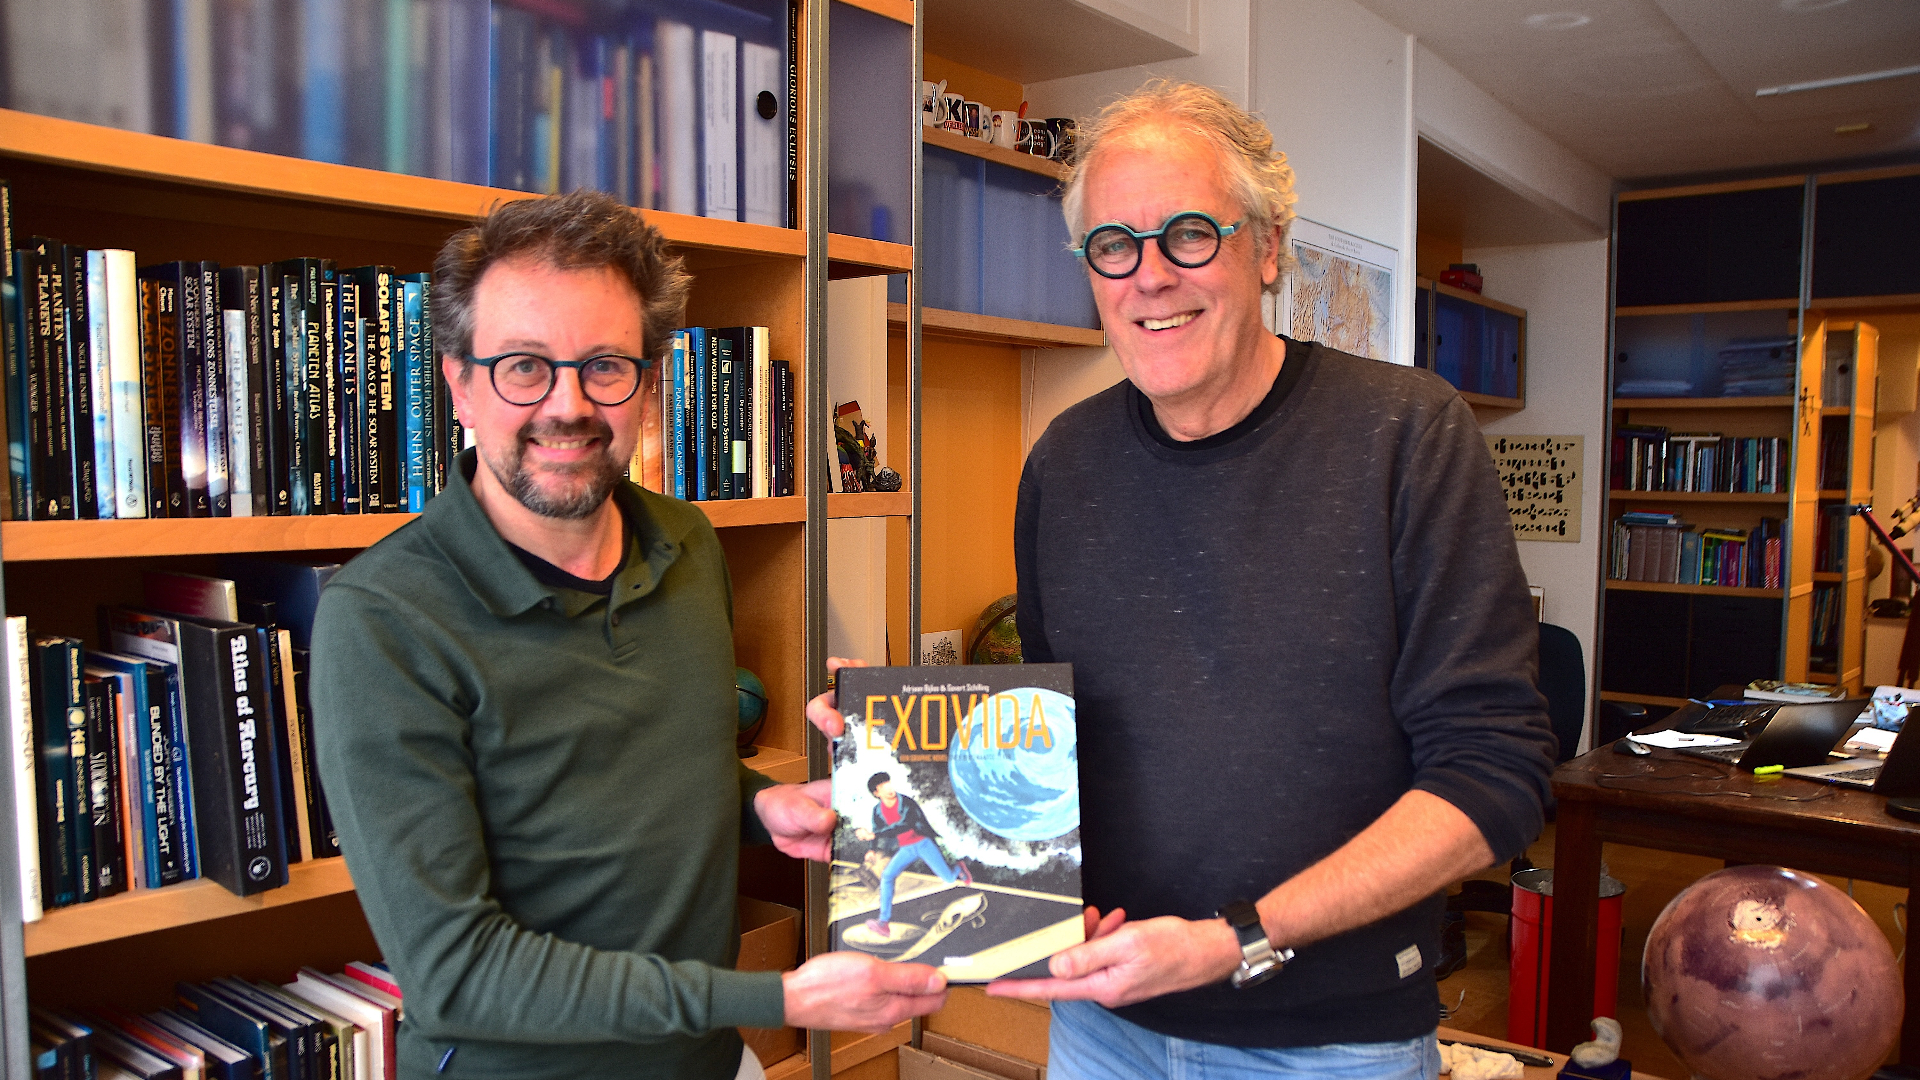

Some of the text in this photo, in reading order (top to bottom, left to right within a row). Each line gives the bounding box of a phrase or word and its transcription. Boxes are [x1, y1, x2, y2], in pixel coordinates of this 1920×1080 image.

[789, 64, 797, 181] GLORIOUS ECLIPSES
[74, 256, 82, 270] DE
[38, 274, 51, 336] PLANETS
[52, 274, 64, 342] PLANETEN
[75, 271, 85, 322] PLANETEN
[193, 277, 201, 329] WONDERS
[271, 286, 280, 297] The
[272, 298, 280, 311] New
[290, 282, 300, 300] The
[325, 288, 334, 302] The
[184, 276, 196, 349] SOLAR SYSTEM
[250, 279, 260, 365] The New Solar System
[272, 312, 281, 328] Solar
[324, 302, 335, 342] Cambridge
[396, 287, 405, 353] HET ZONNESTELSEL
[203, 271, 219, 430] DE MAGIE VAN ONS ZONNESTELSEL
[292, 325, 301, 349] Solar
[343, 282, 357, 396] THE PLANETS
[367, 334, 376, 351] THE
[377, 273, 393, 411] SOLAR SYSTEM
[408, 318, 421, 362] SPACE
[77, 341, 87, 370] NIGEL
[291, 352, 302, 386] System
[308, 322, 321, 420] PLANETEN ATLAS
[325, 342, 336, 391] Photographic
[367, 352, 377, 382] ATLAS
[79, 372, 89, 414] HENBEST
[161, 325, 180, 473] ZONNESTELSEL
[327, 391, 336, 409] Atlas
[368, 382, 377, 396] OF
[410, 368, 422, 419] OUTER
[422, 281, 434, 489] EARTH AND OTHER PLANETS Cattermole
[234, 381, 243, 436] PLANETS
[368, 398, 378, 416] THE
[675, 387, 683, 428] PLANETARY
[721, 393, 730, 427] Planetary
[739, 399, 745, 407] De
[328, 416, 337, 429] the
[368, 417, 379, 449] SOLAR
[328, 429, 338, 457] Planets
[411, 430, 424, 477] HAHN
[722, 427, 730, 454] System
[369, 449, 380, 484] SYSTEM
[313, 472, 322, 506] ROSTRUM
[268, 630, 278, 643] The
[230, 635, 250, 693] Atlas
[71, 678, 81, 704] Books
[940, 684, 947, 692] &
[946, 683, 966, 692] Govert
[965, 683, 990, 693] Schilling
[235, 695, 255, 717] of
[865, 693, 1053, 751] EXOVIDA
[149, 706, 164, 764] BLINDED
[153, 766, 165, 784] BY
[238, 718, 260, 811] Mercury
[155, 786, 167, 815] THE
[157, 817, 170, 855] LIGHT
